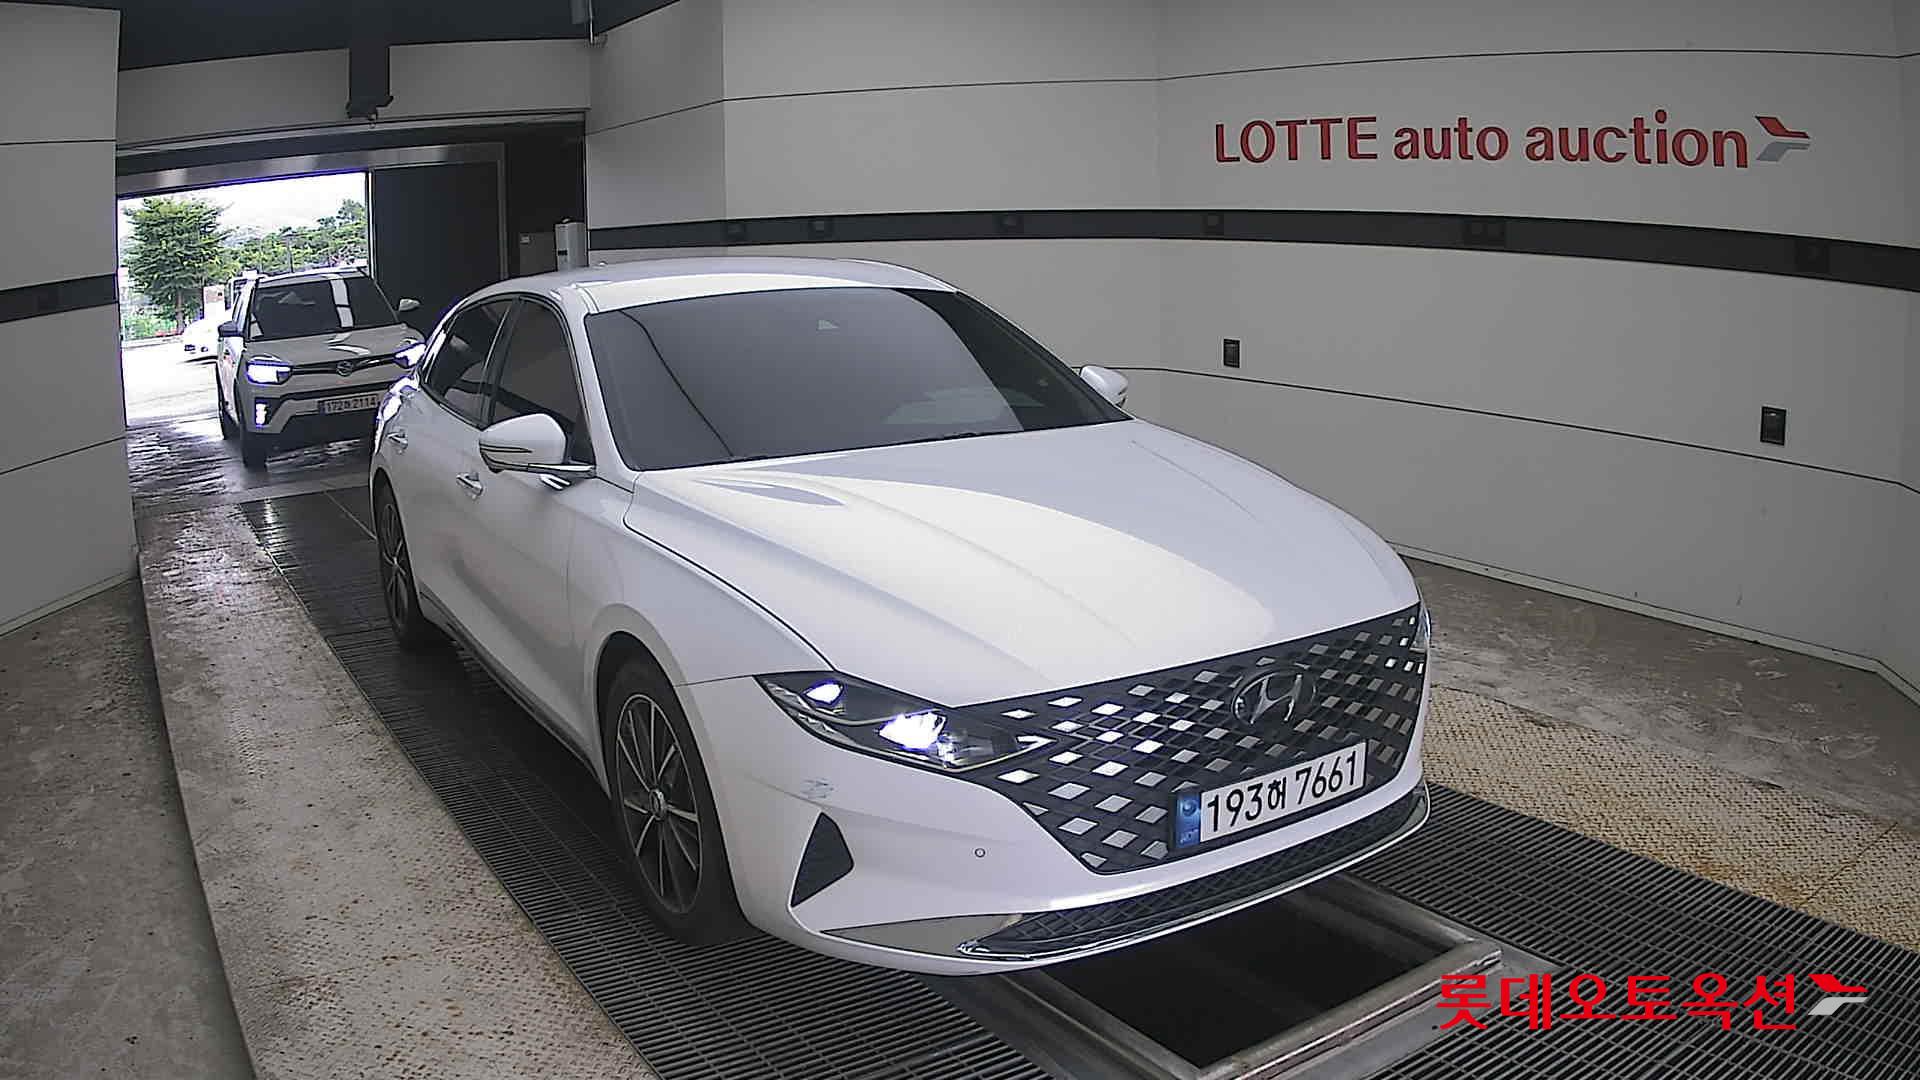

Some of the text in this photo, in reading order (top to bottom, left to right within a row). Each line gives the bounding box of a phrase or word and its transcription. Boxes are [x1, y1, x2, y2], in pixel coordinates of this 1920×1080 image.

[1215, 109, 1749, 169] LOTTE auto auction
[1207, 750, 1357, 832] 193허 7661
